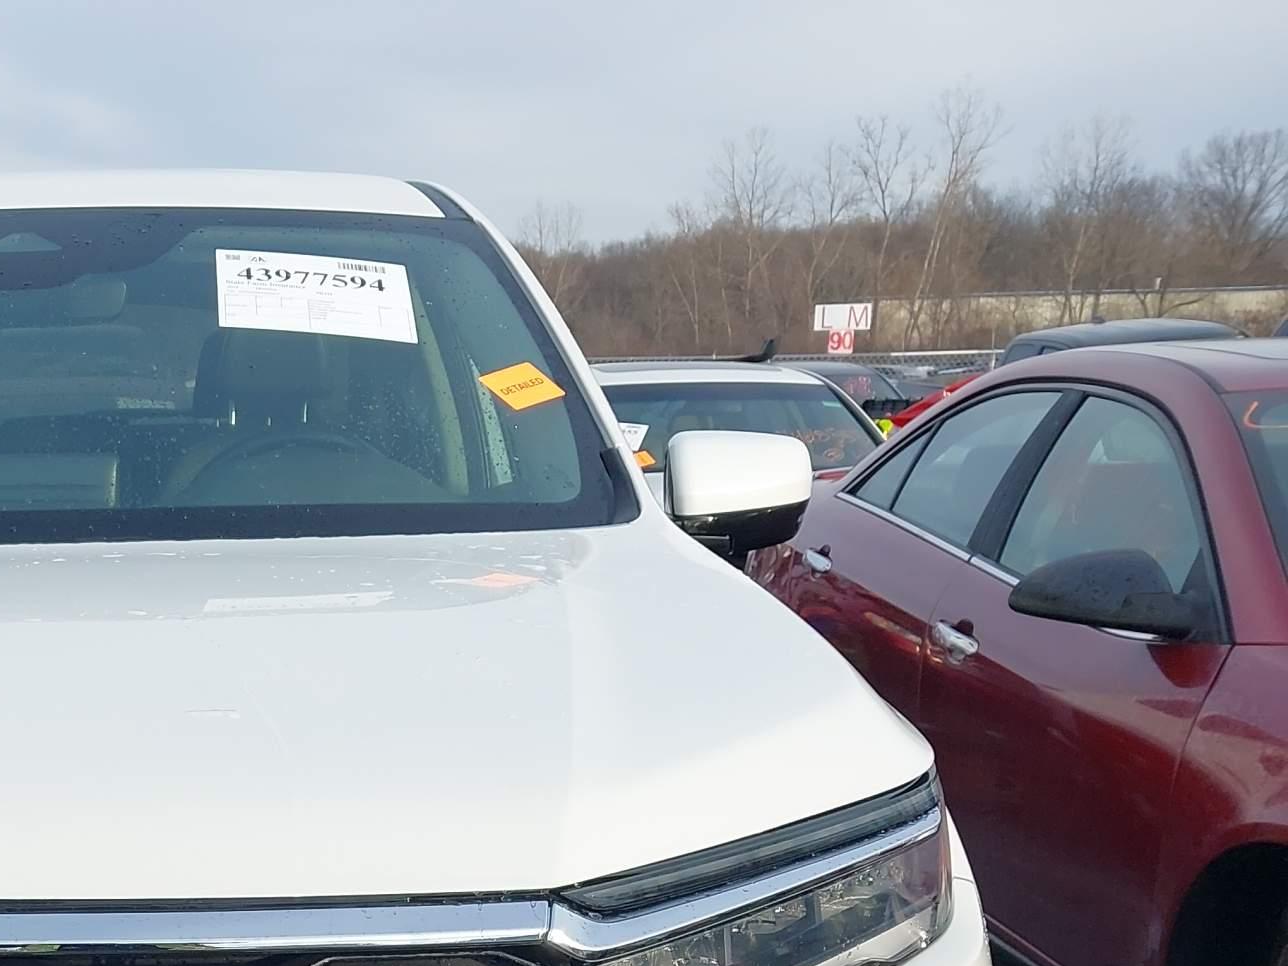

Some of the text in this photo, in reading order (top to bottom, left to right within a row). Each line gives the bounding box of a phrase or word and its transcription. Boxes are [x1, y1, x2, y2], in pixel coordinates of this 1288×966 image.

[237, 266, 386, 292] 43977594
[821, 305, 868, 329] L M
[830, 331, 853, 351] 90
[499, 377, 545, 396] DETAILED
